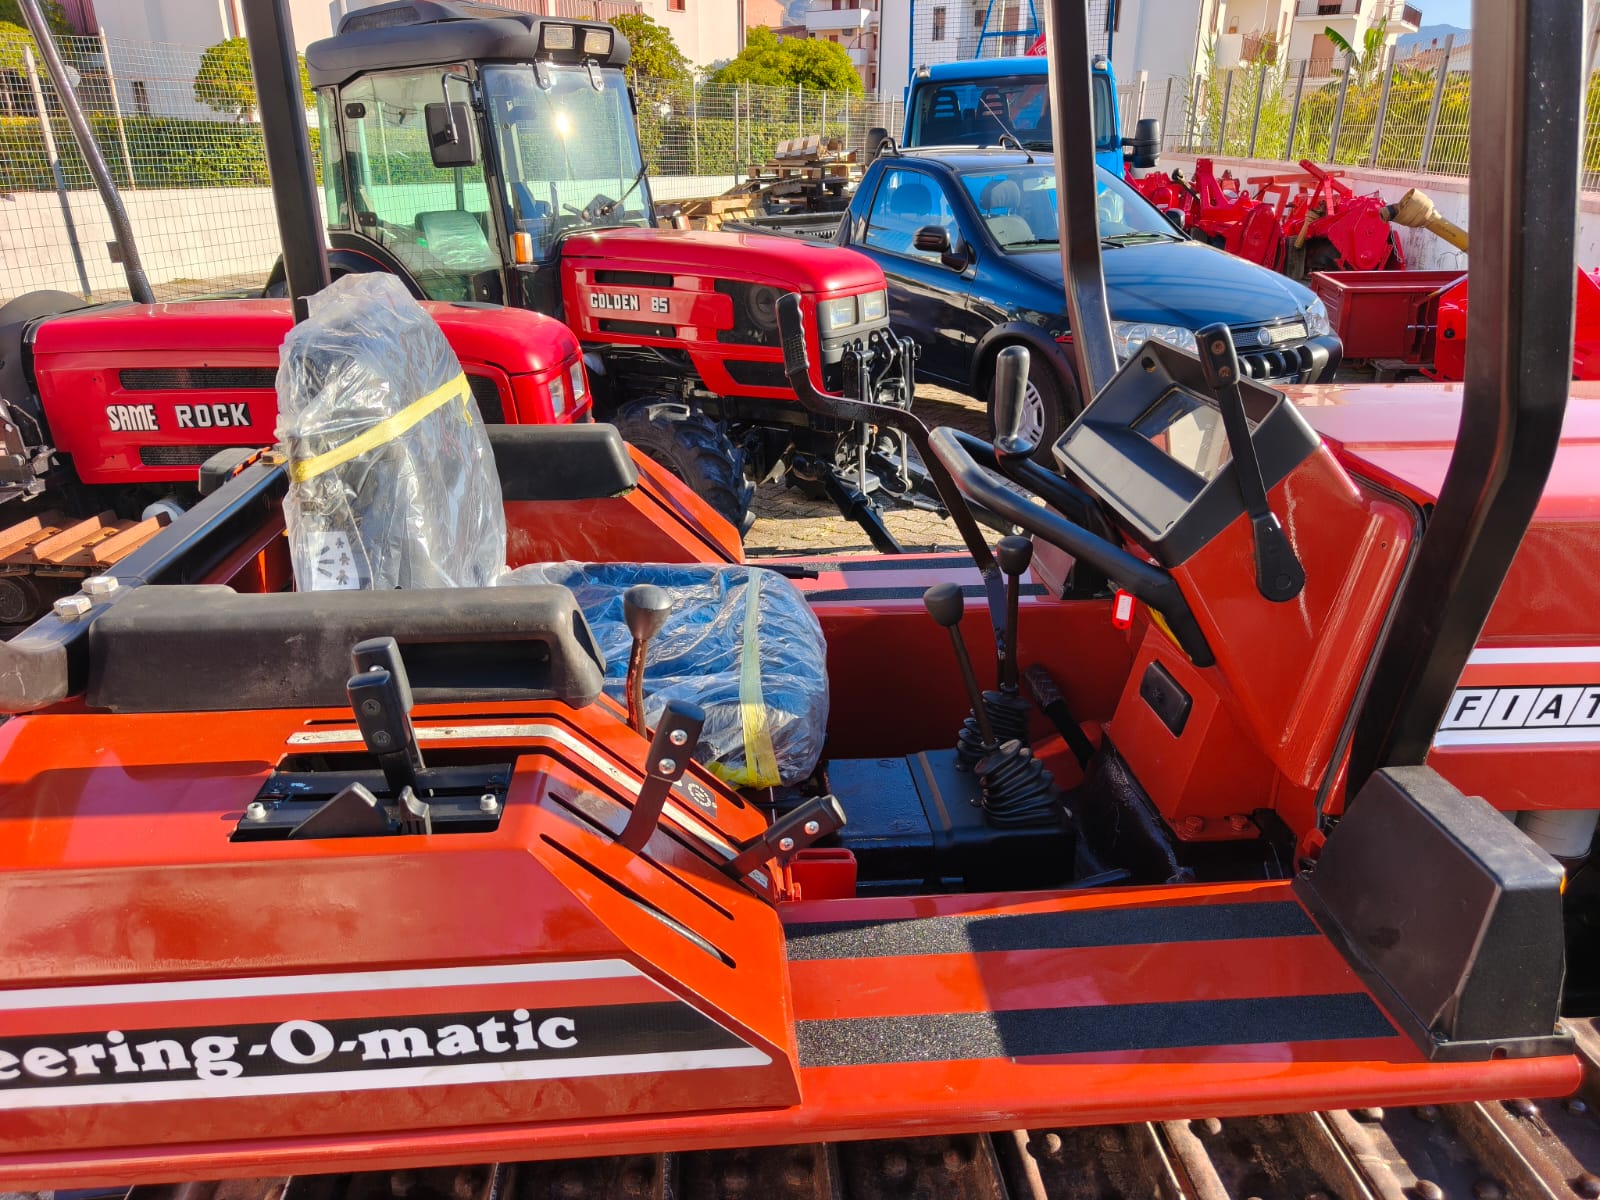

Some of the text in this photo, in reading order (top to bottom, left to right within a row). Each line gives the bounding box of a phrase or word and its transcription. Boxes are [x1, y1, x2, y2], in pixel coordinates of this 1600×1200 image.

[590, 292, 669, 313] GOLDEN 85
[106, 402, 251, 432] SAME ROCK
[1452, 694, 1600, 721] FIAT
